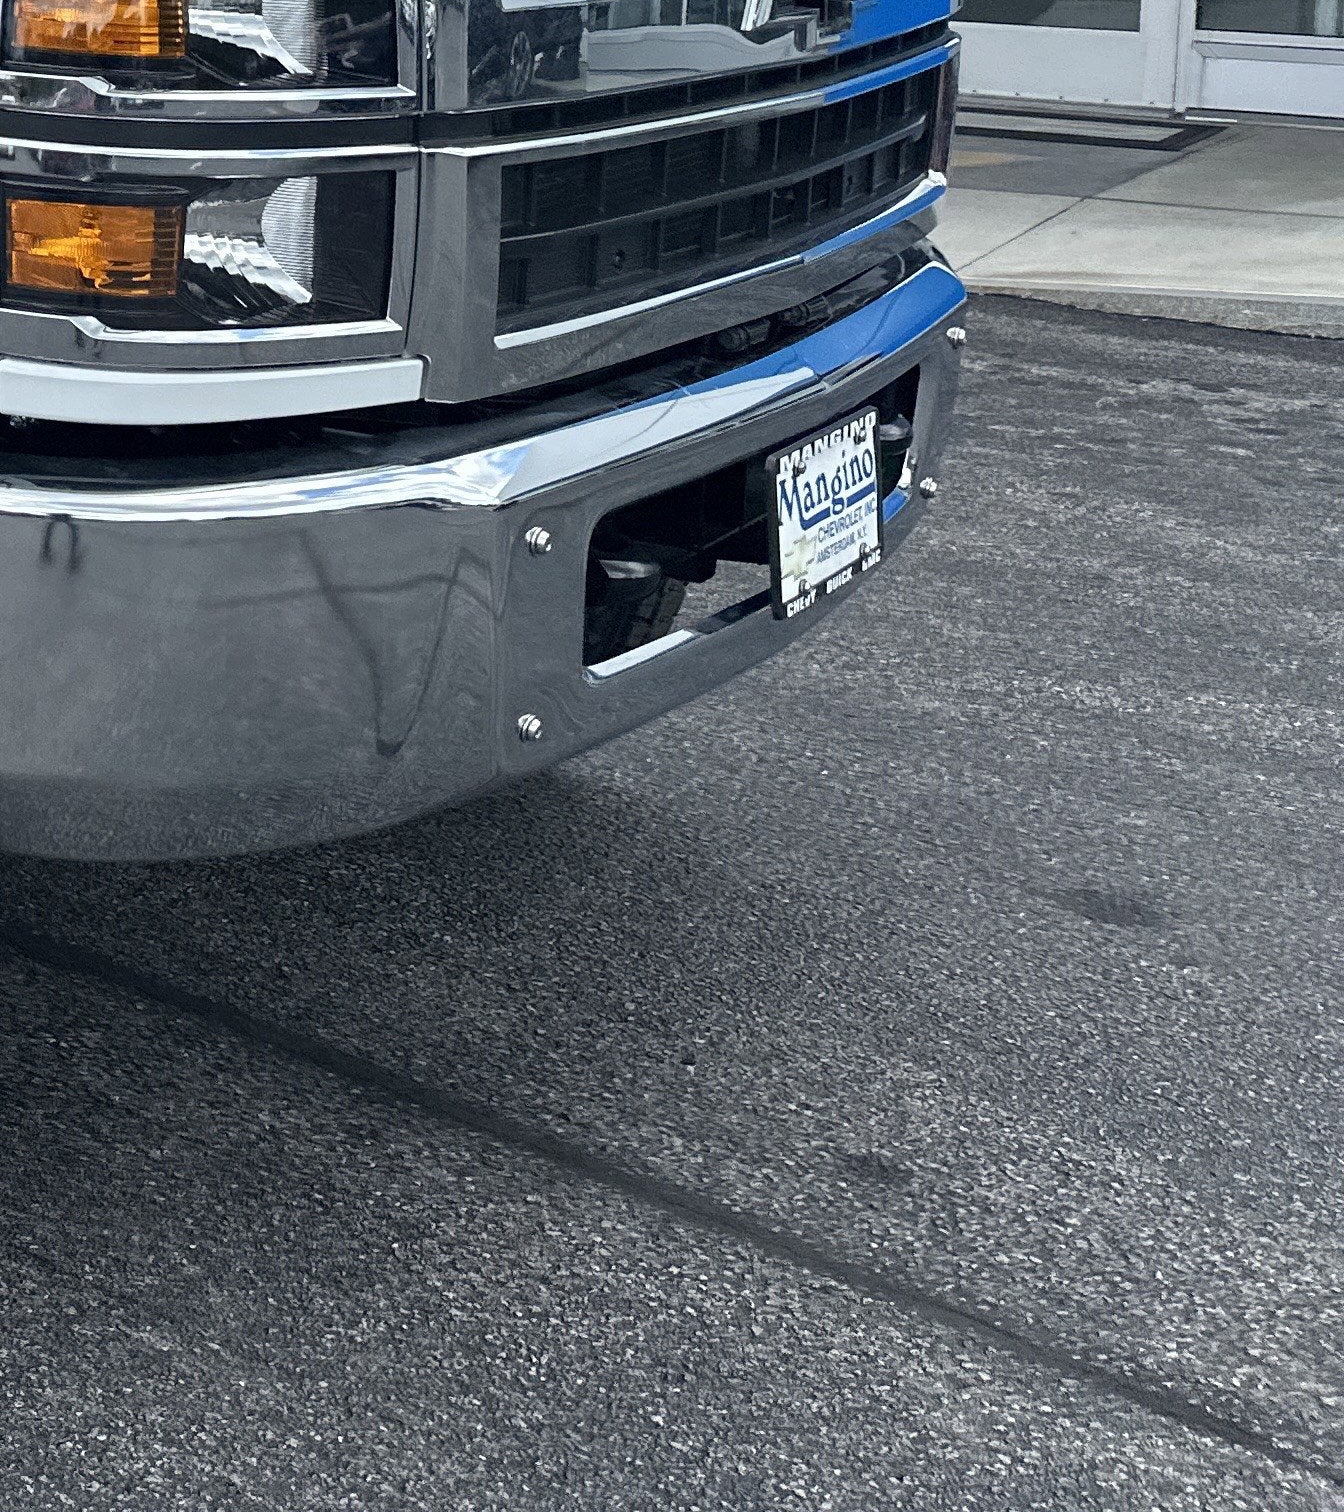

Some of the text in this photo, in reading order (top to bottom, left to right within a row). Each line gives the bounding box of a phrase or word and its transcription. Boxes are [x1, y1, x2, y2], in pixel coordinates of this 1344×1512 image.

[779, 411, 877, 476] MANGINO
[778, 448, 874, 530] Mangino
[787, 588, 816, 618] CHEVY
[826, 566, 853, 595] BUICK
